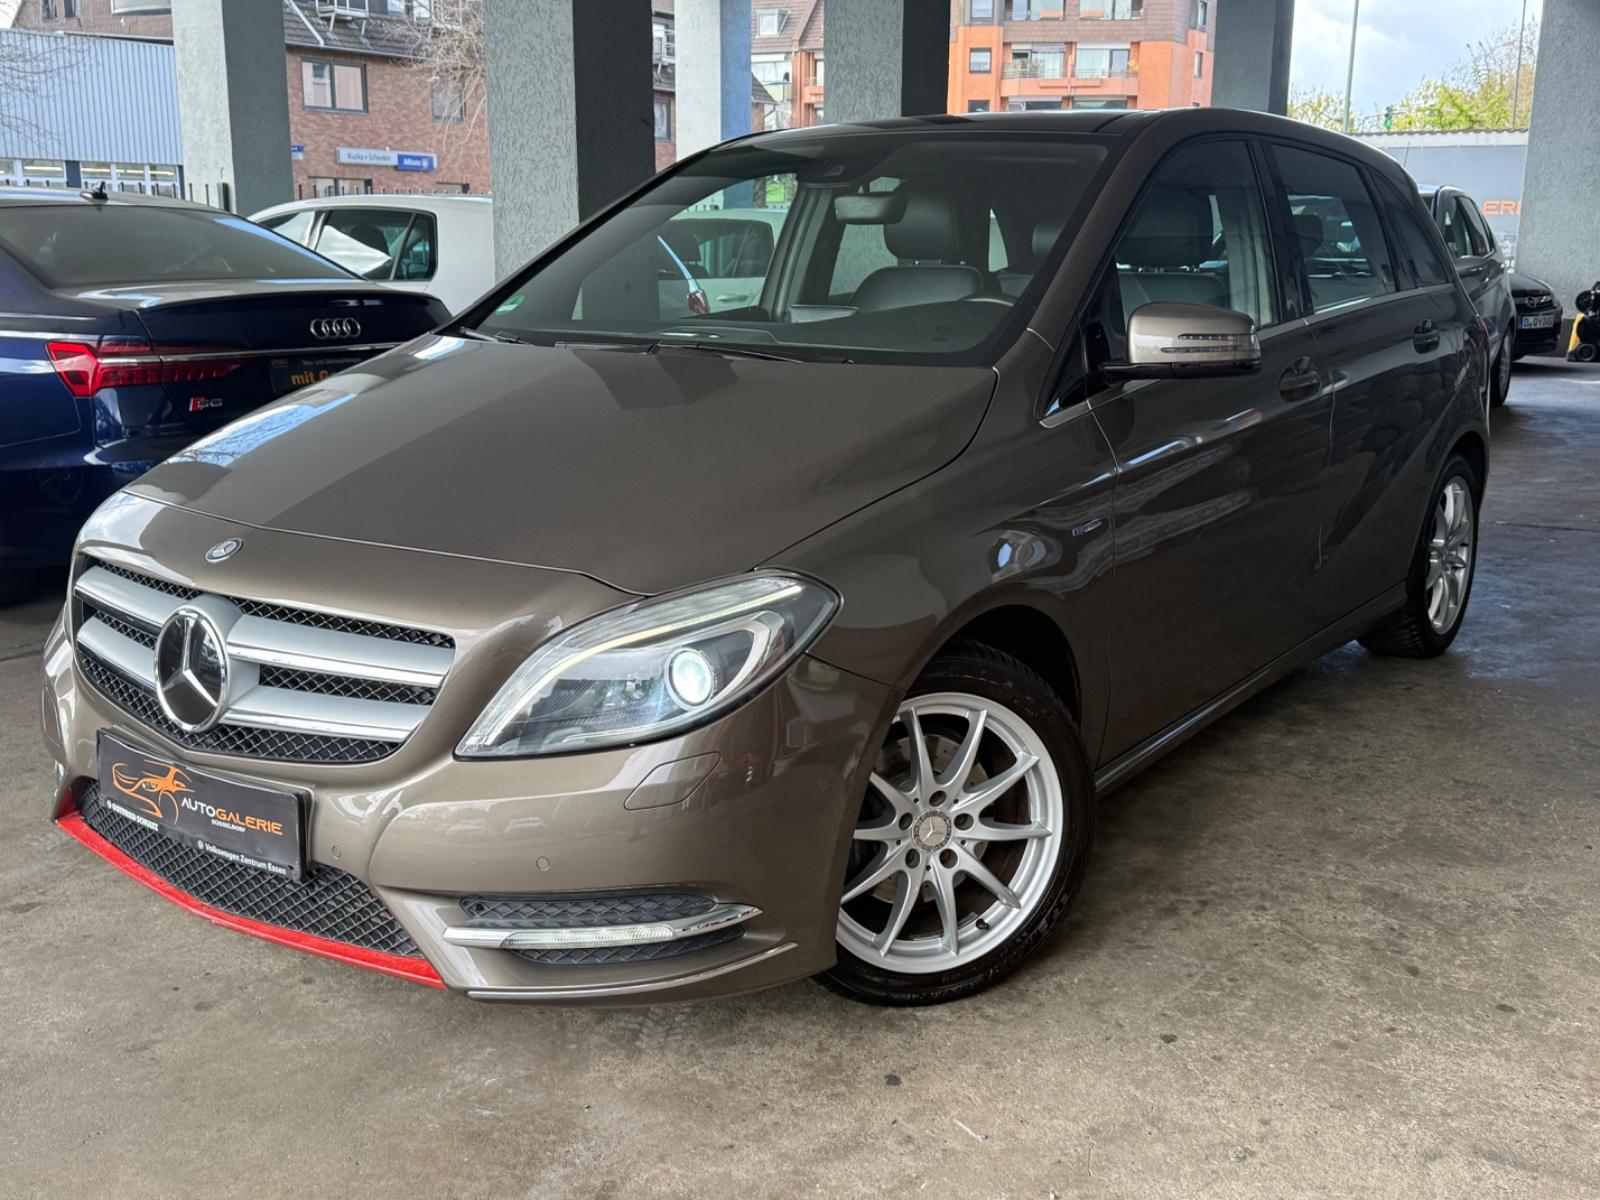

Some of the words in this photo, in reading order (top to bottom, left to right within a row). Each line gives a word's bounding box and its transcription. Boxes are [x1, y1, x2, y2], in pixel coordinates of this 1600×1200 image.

[403, 158, 421, 166] Allianz
[291, 371, 316, 384] mit
[181, 797, 283, 836] AUTOGALERIE
[205, 842, 240, 862] Volkswagen
[240, 854, 267, 870] Zentrum
[267, 862, 287, 875] Essen
